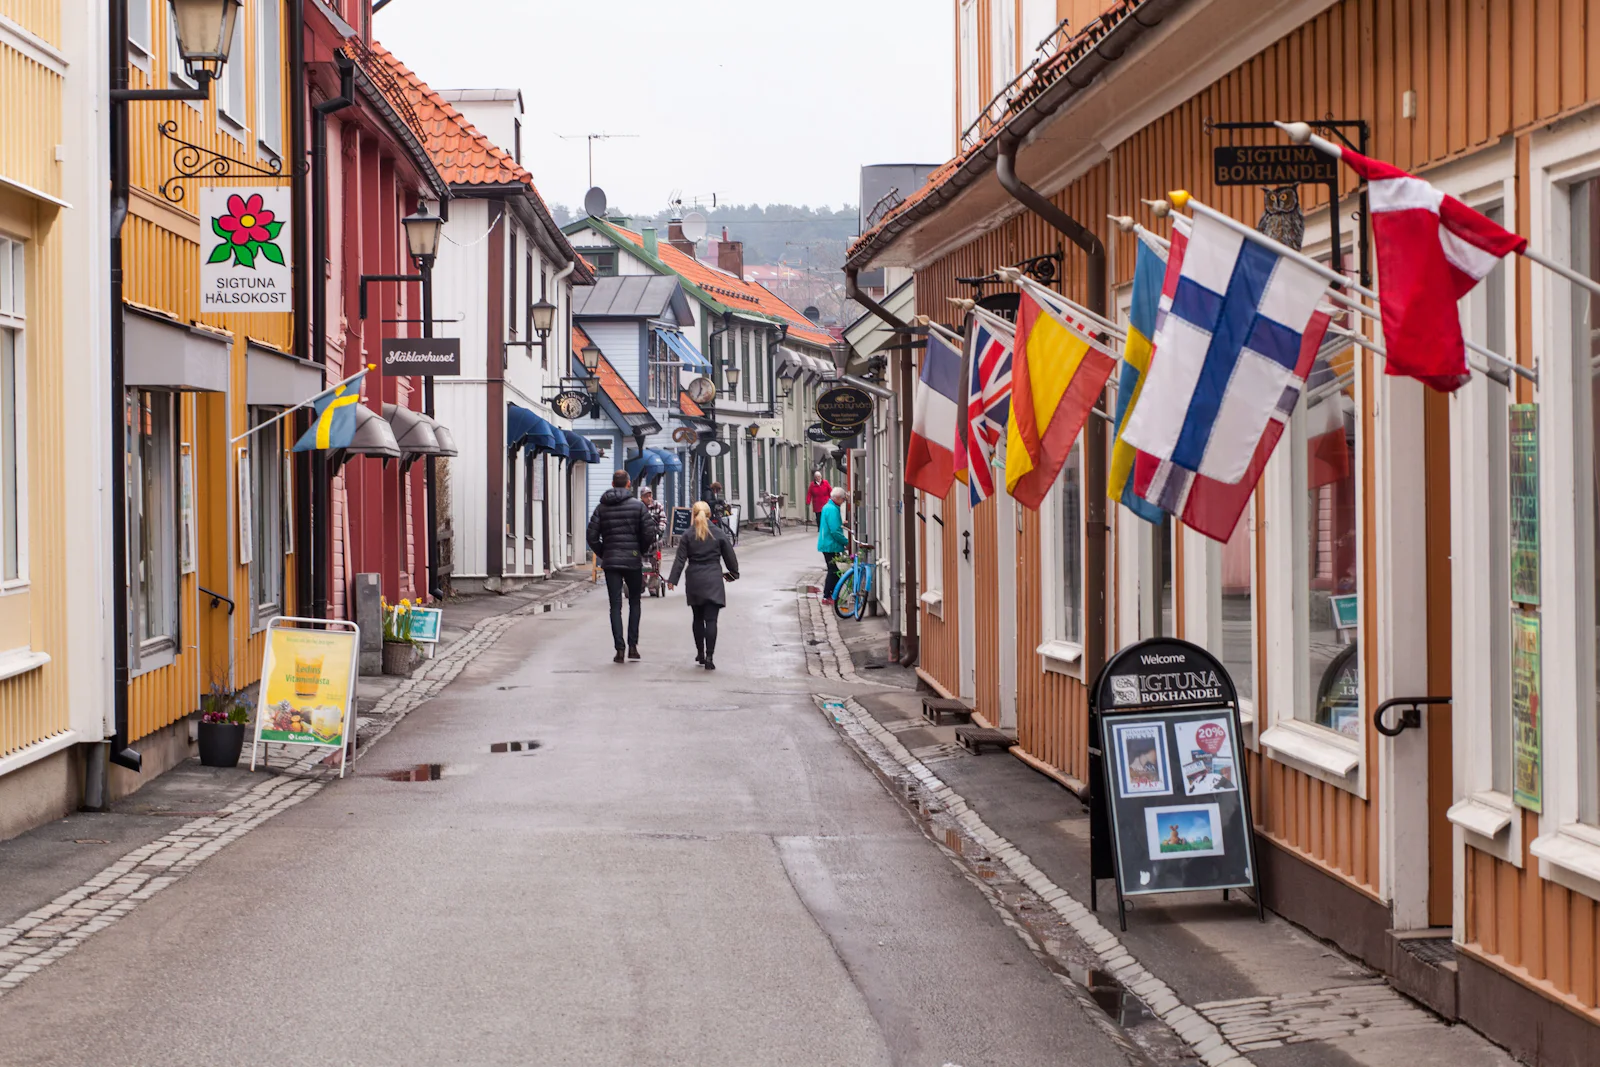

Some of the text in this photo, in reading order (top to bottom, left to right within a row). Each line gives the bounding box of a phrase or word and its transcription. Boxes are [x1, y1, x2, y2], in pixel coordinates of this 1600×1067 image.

[1237, 149, 1317, 163] SIGTUNA
[1218, 165, 1336, 181] BOKHANDEL
[216, 277, 275, 289] SIGTUNA
[205, 291, 286, 304] HÄLSOKOST
[385, 351, 455, 364] Mäklarhuset
[1140, 653, 1186, 665] Welcome
[296, 664, 321, 674] Ledins
[1141, 688, 1222, 703] BOKHANDEL
[1198, 727, 1224, 739] 20%
